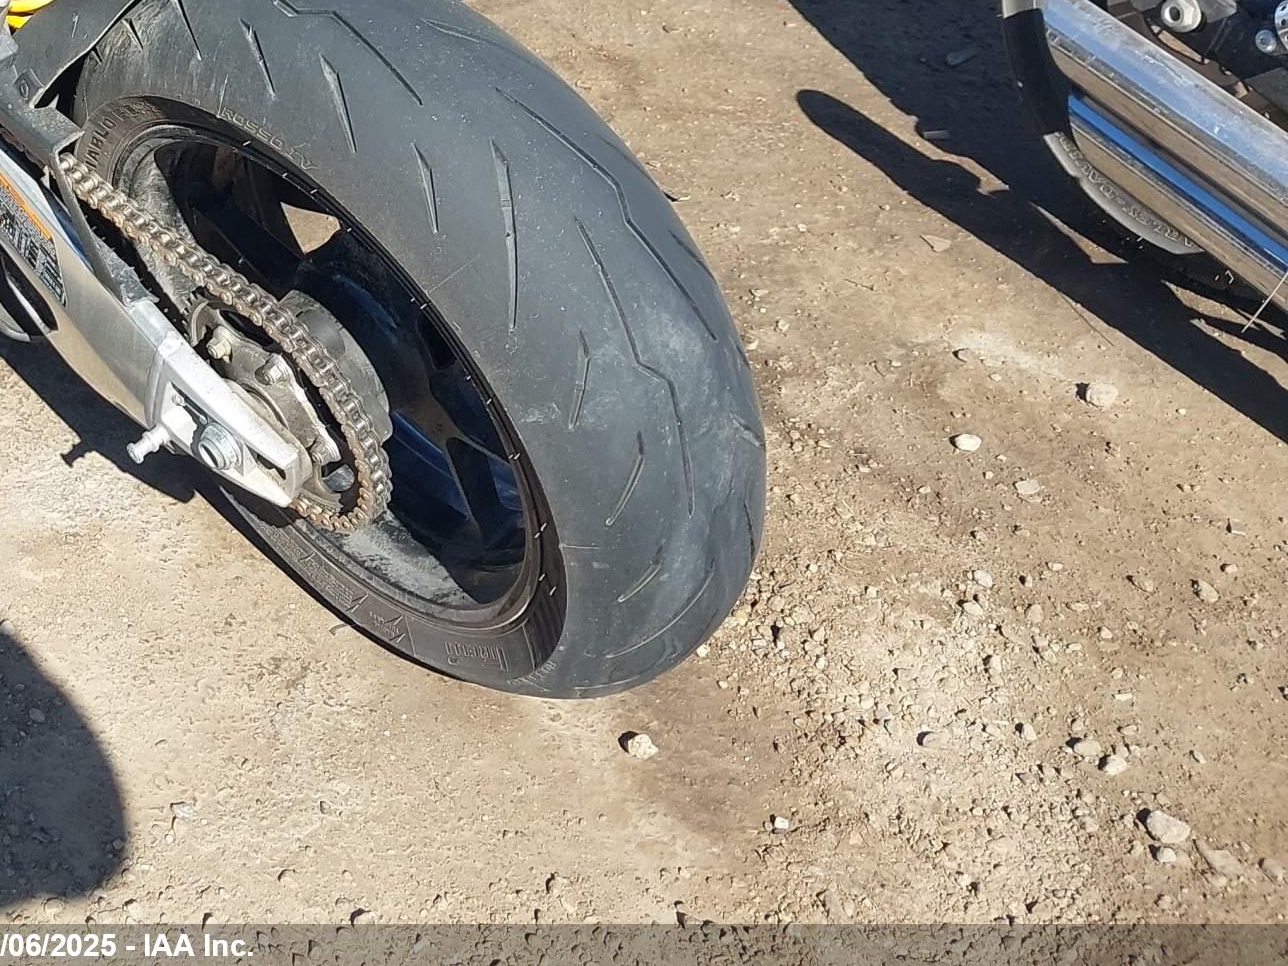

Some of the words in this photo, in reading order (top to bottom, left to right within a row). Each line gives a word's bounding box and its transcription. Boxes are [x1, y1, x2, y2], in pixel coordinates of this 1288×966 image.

[83, 113, 119, 171] IABLO
[218, 105, 285, 152] ROSSO
[1058, 131, 1194, 248] ARLEY-DAVID
